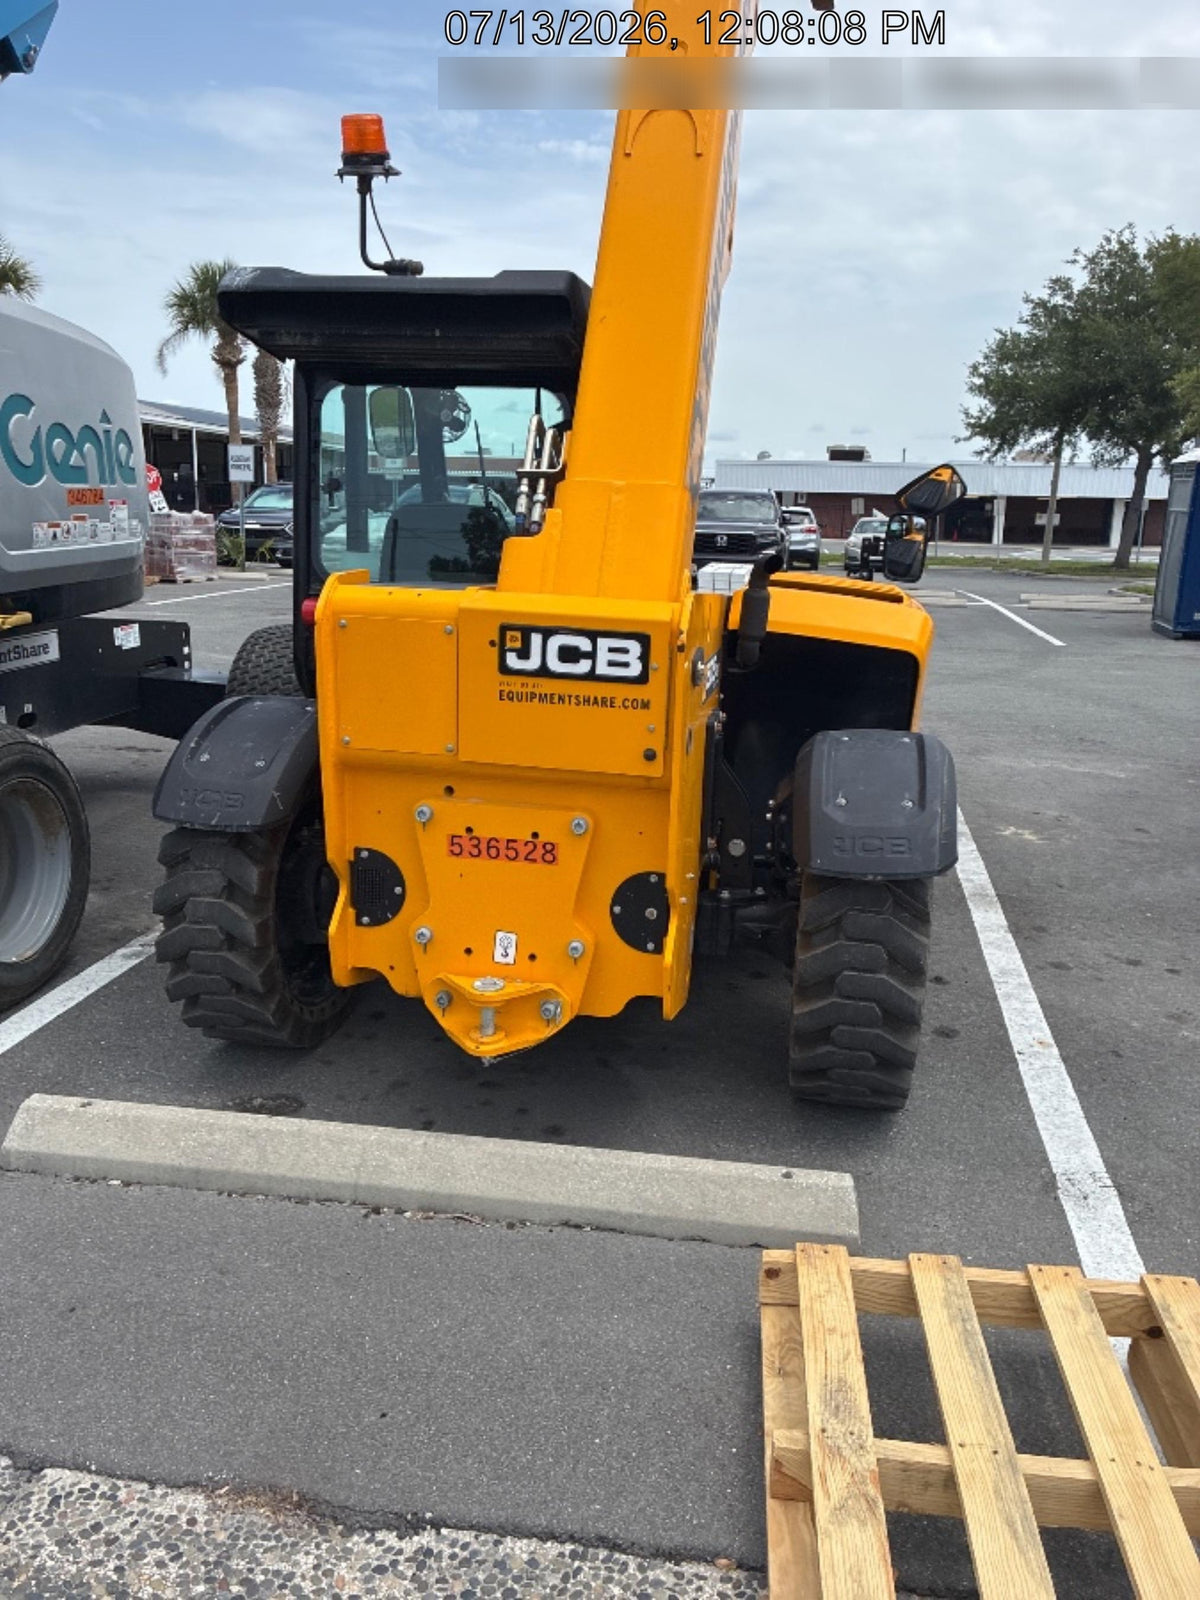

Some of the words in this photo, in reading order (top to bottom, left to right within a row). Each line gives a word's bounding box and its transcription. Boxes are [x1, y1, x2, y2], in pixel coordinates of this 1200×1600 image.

[0, 393, 137, 485] Genie
[505, 632, 643, 677] JCB
[498, 689, 650, 710] EQUIPMENTSHARE.COM
[450, 835, 557, 863] 536528
[833, 836, 912, 858] JCB
